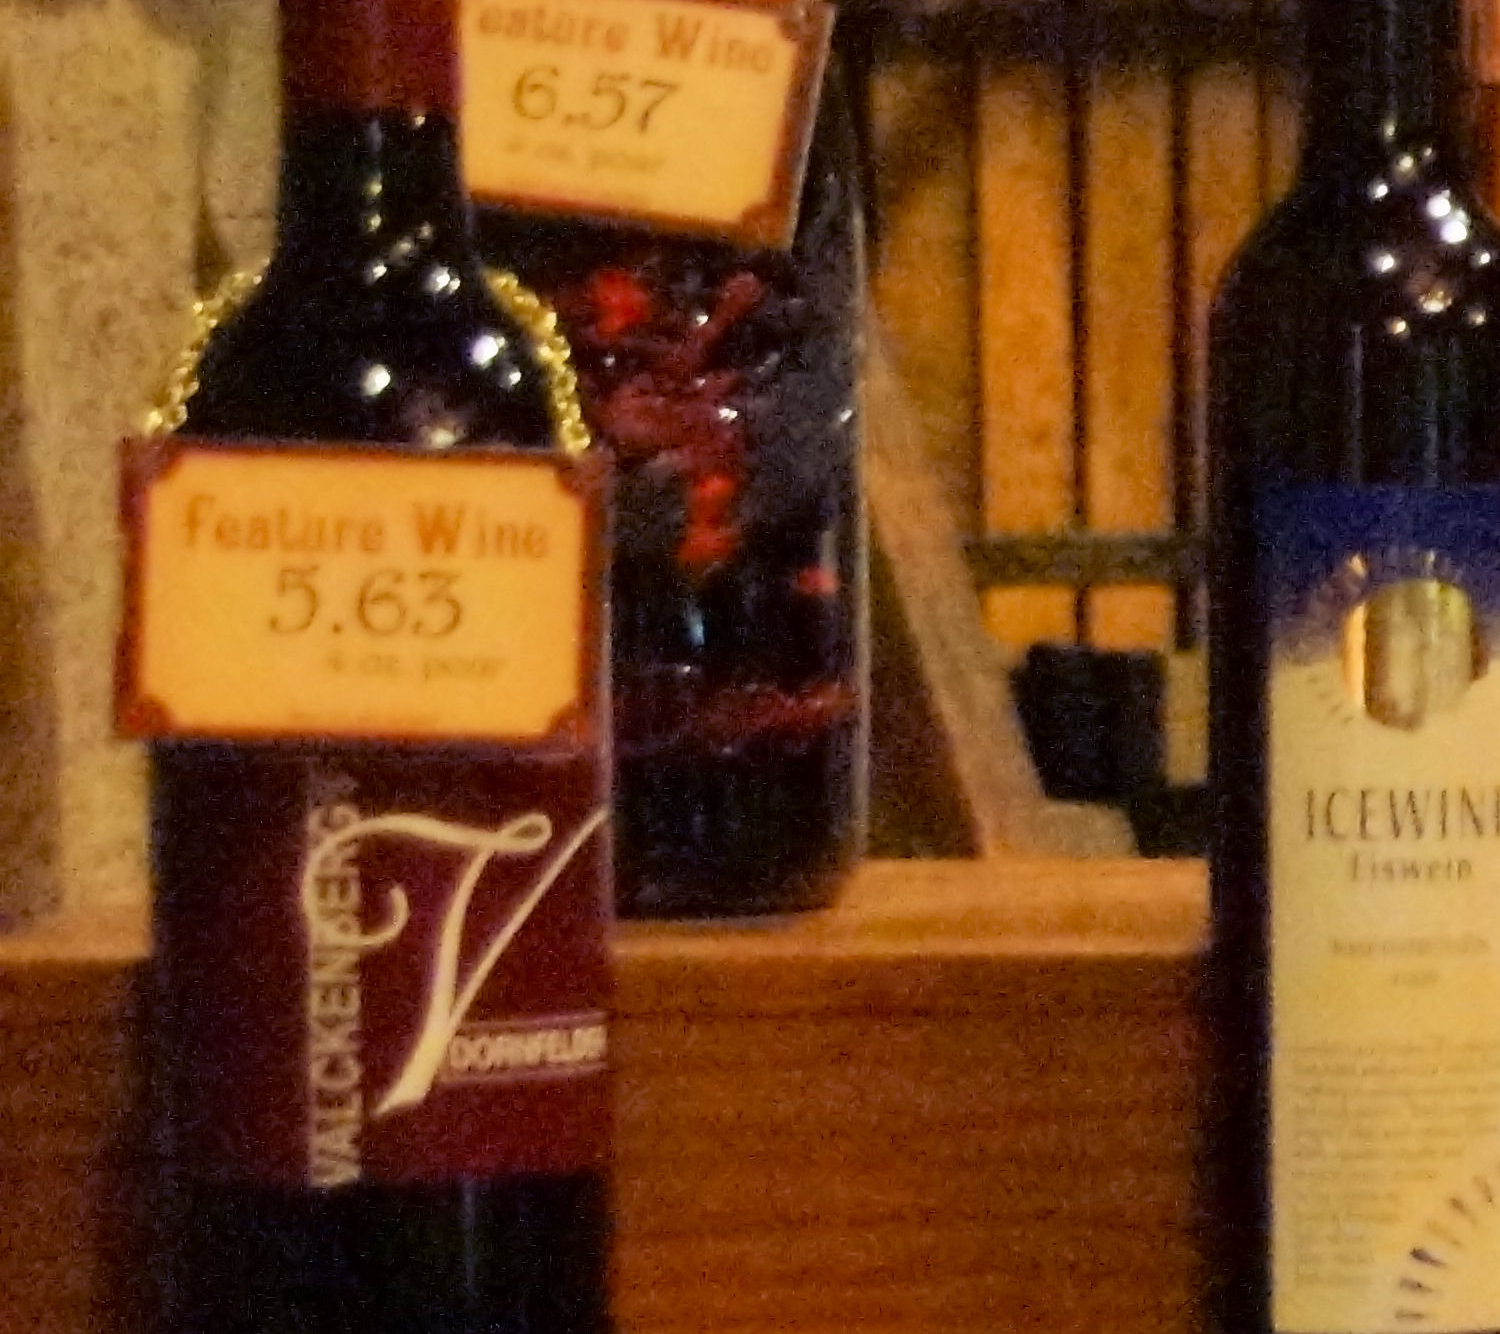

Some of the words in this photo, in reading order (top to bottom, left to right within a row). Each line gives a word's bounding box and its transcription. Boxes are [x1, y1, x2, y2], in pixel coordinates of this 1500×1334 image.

[654, 11, 780, 75] Wine
[509, 67, 679, 138] 6.57
[181, 493, 387, 552] Feature
[411, 500, 550, 560] Wine
[268, 564, 465, 639] 5.63
